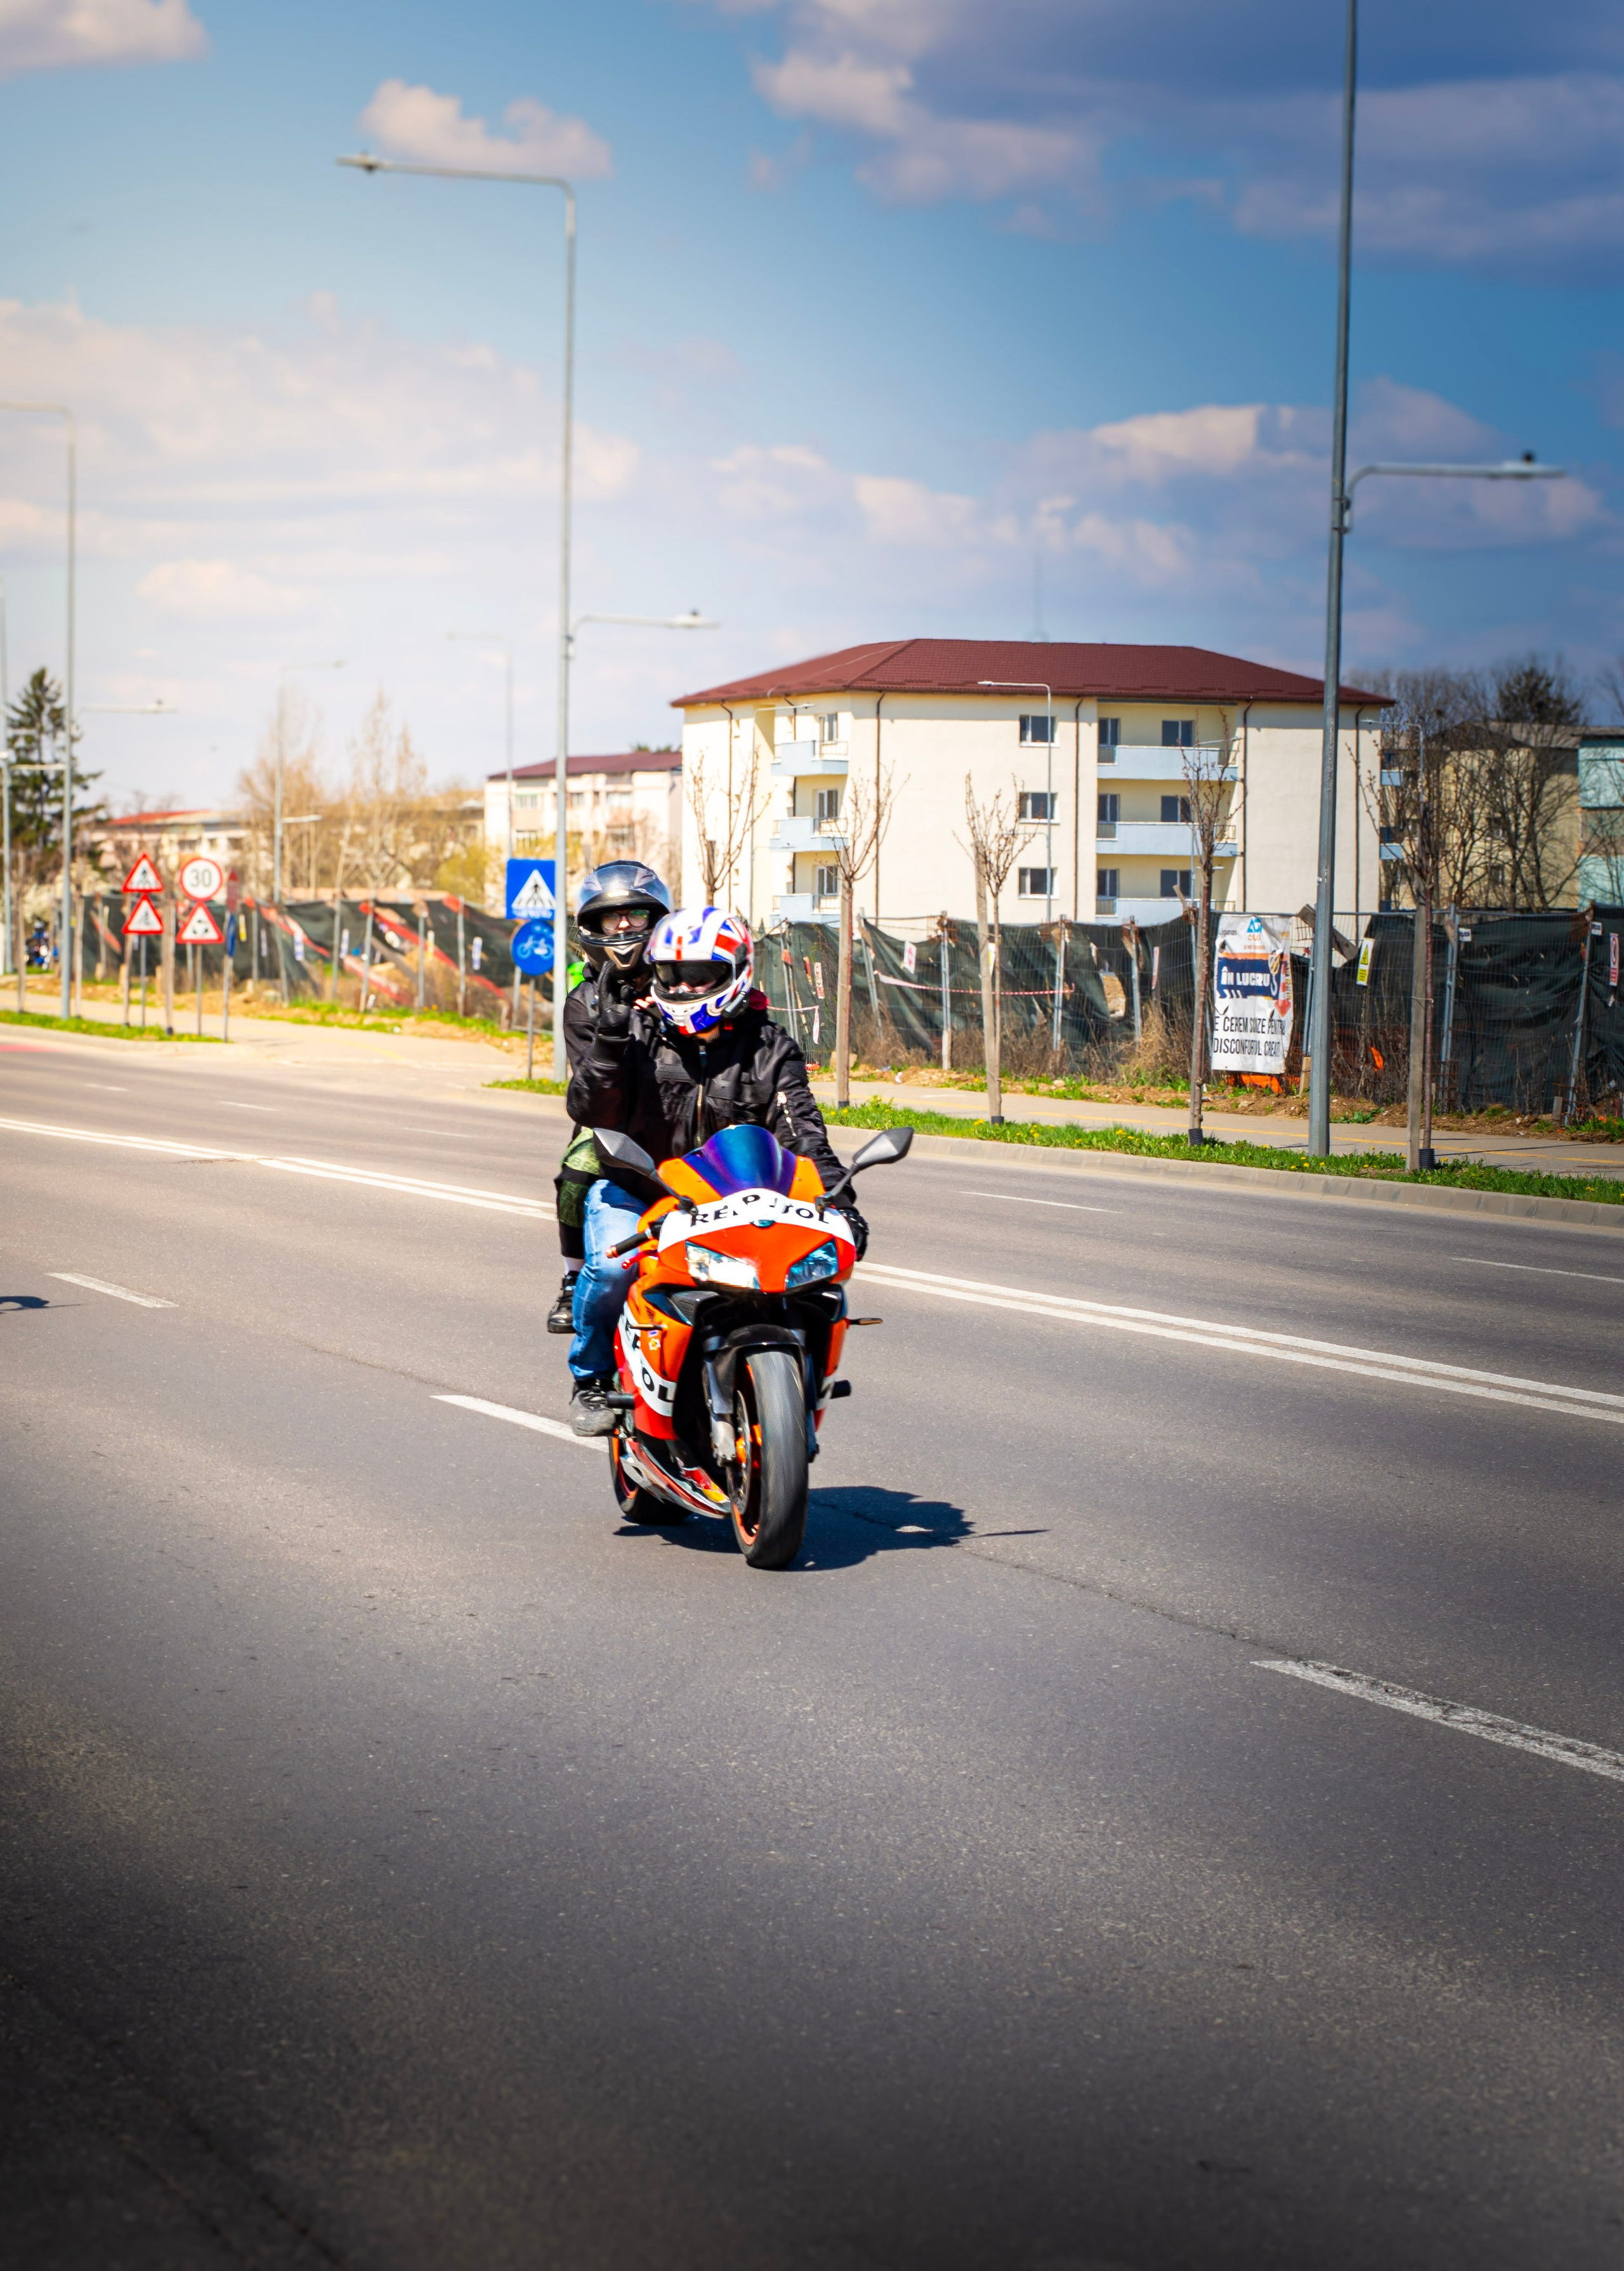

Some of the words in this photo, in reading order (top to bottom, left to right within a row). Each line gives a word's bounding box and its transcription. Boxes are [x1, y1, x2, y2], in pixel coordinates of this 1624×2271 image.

[190, 868, 212, 887] 30
[1221, 965, 1234, 985] ÎN
[1236, 972, 1271, 987] LUCRU
